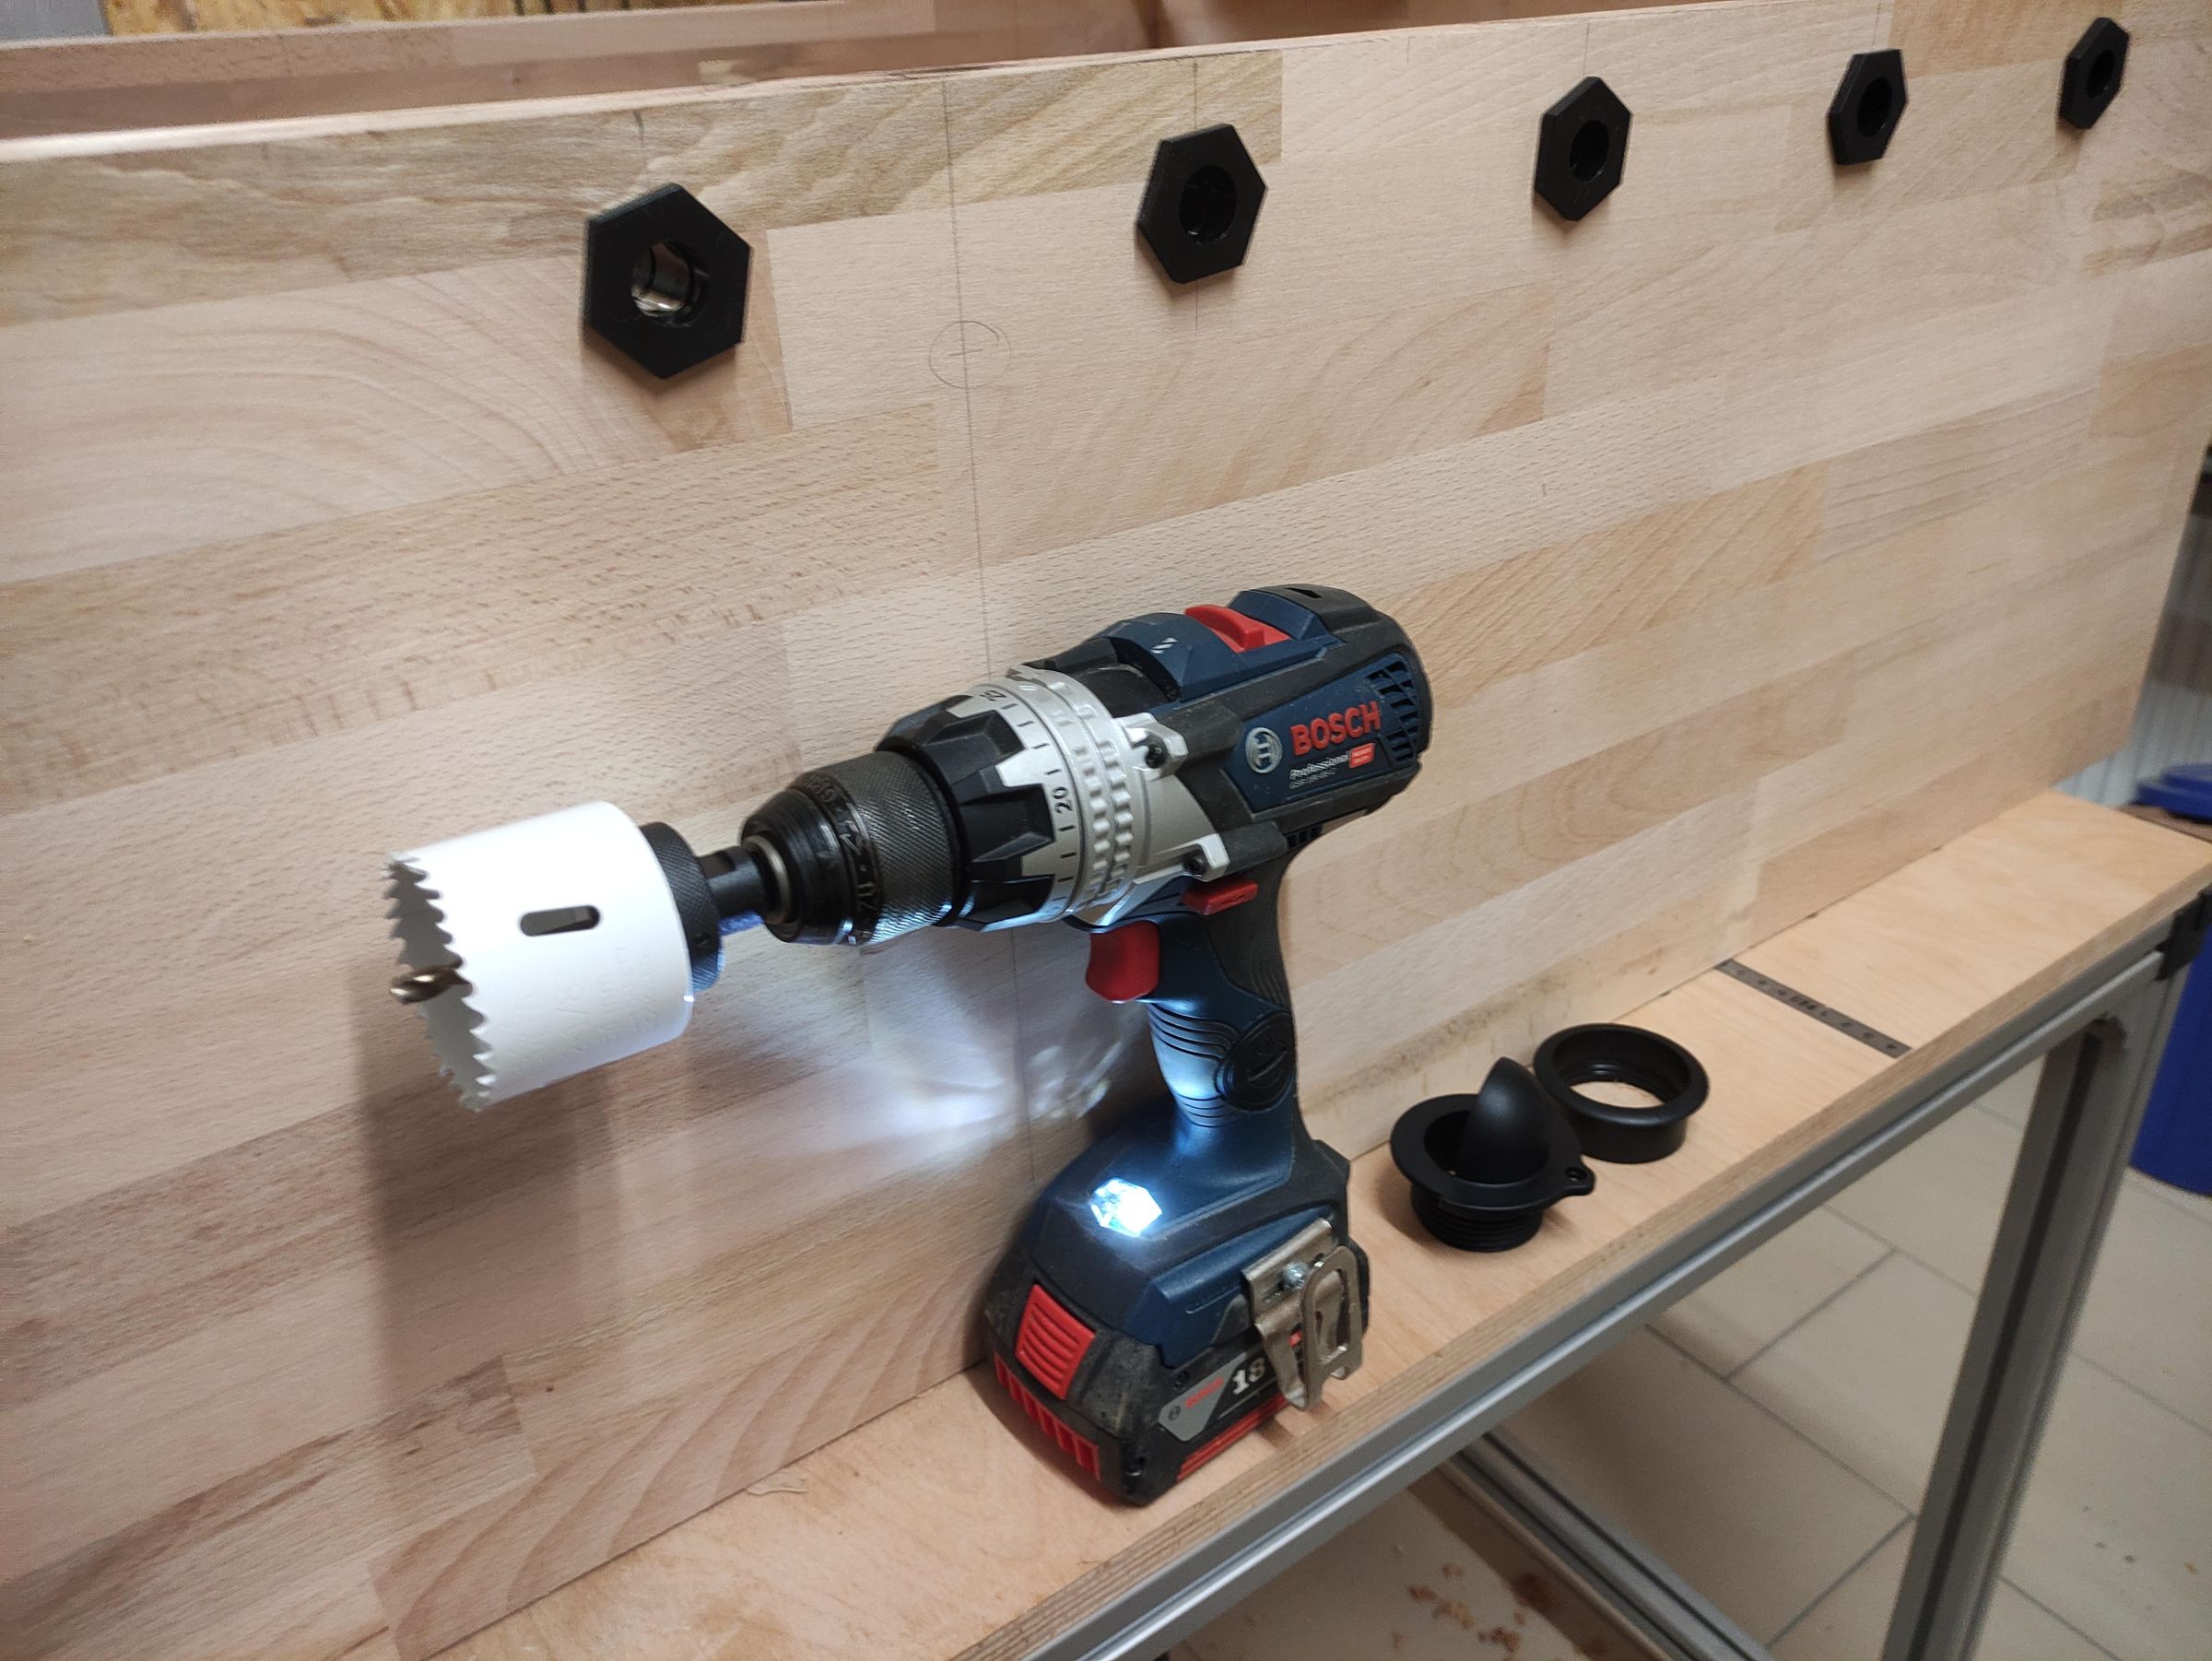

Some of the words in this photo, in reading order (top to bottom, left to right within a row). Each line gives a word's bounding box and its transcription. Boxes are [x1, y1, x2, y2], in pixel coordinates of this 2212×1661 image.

[1290, 701, 1381, 756] BOSCH
[1052, 786, 1074, 815] 20
[1232, 1357, 1266, 1396] 18
